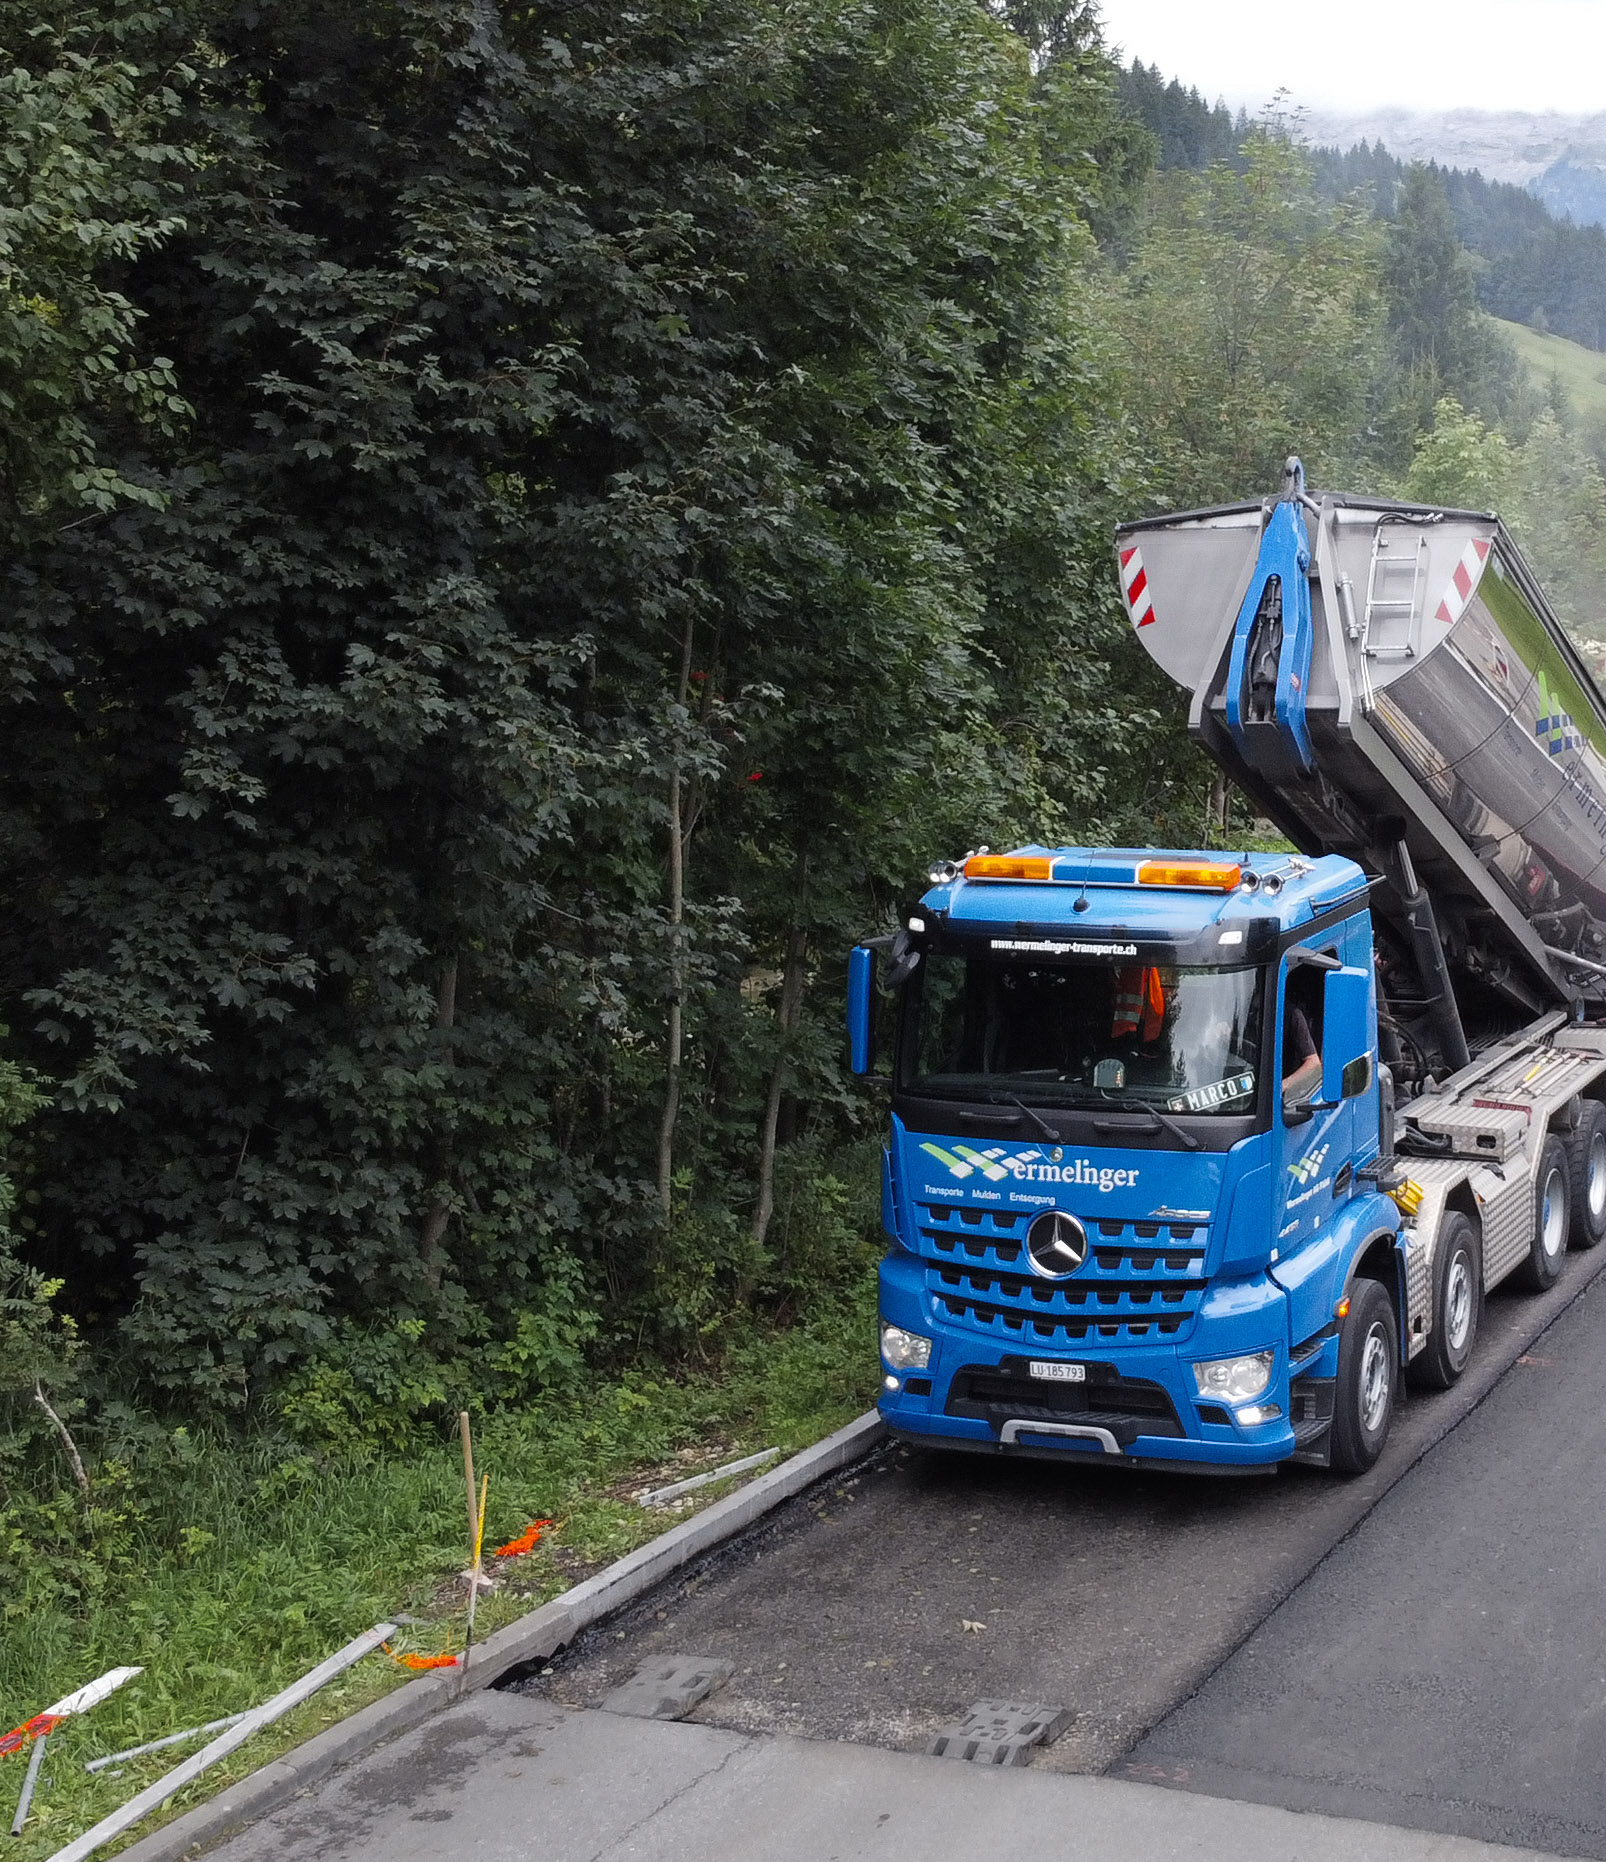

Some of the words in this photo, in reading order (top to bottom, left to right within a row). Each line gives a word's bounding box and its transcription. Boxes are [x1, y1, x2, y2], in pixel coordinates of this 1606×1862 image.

[991, 939, 1138, 957] www.wermelinger-transporte.ch
[1187, 1080, 1238, 1111] MARCO
[925, 1184, 964, 1198] Transporte
[972, 1189, 1001, 1200] Mulden
[1009, 1192, 1056, 1206] Entsorgung
